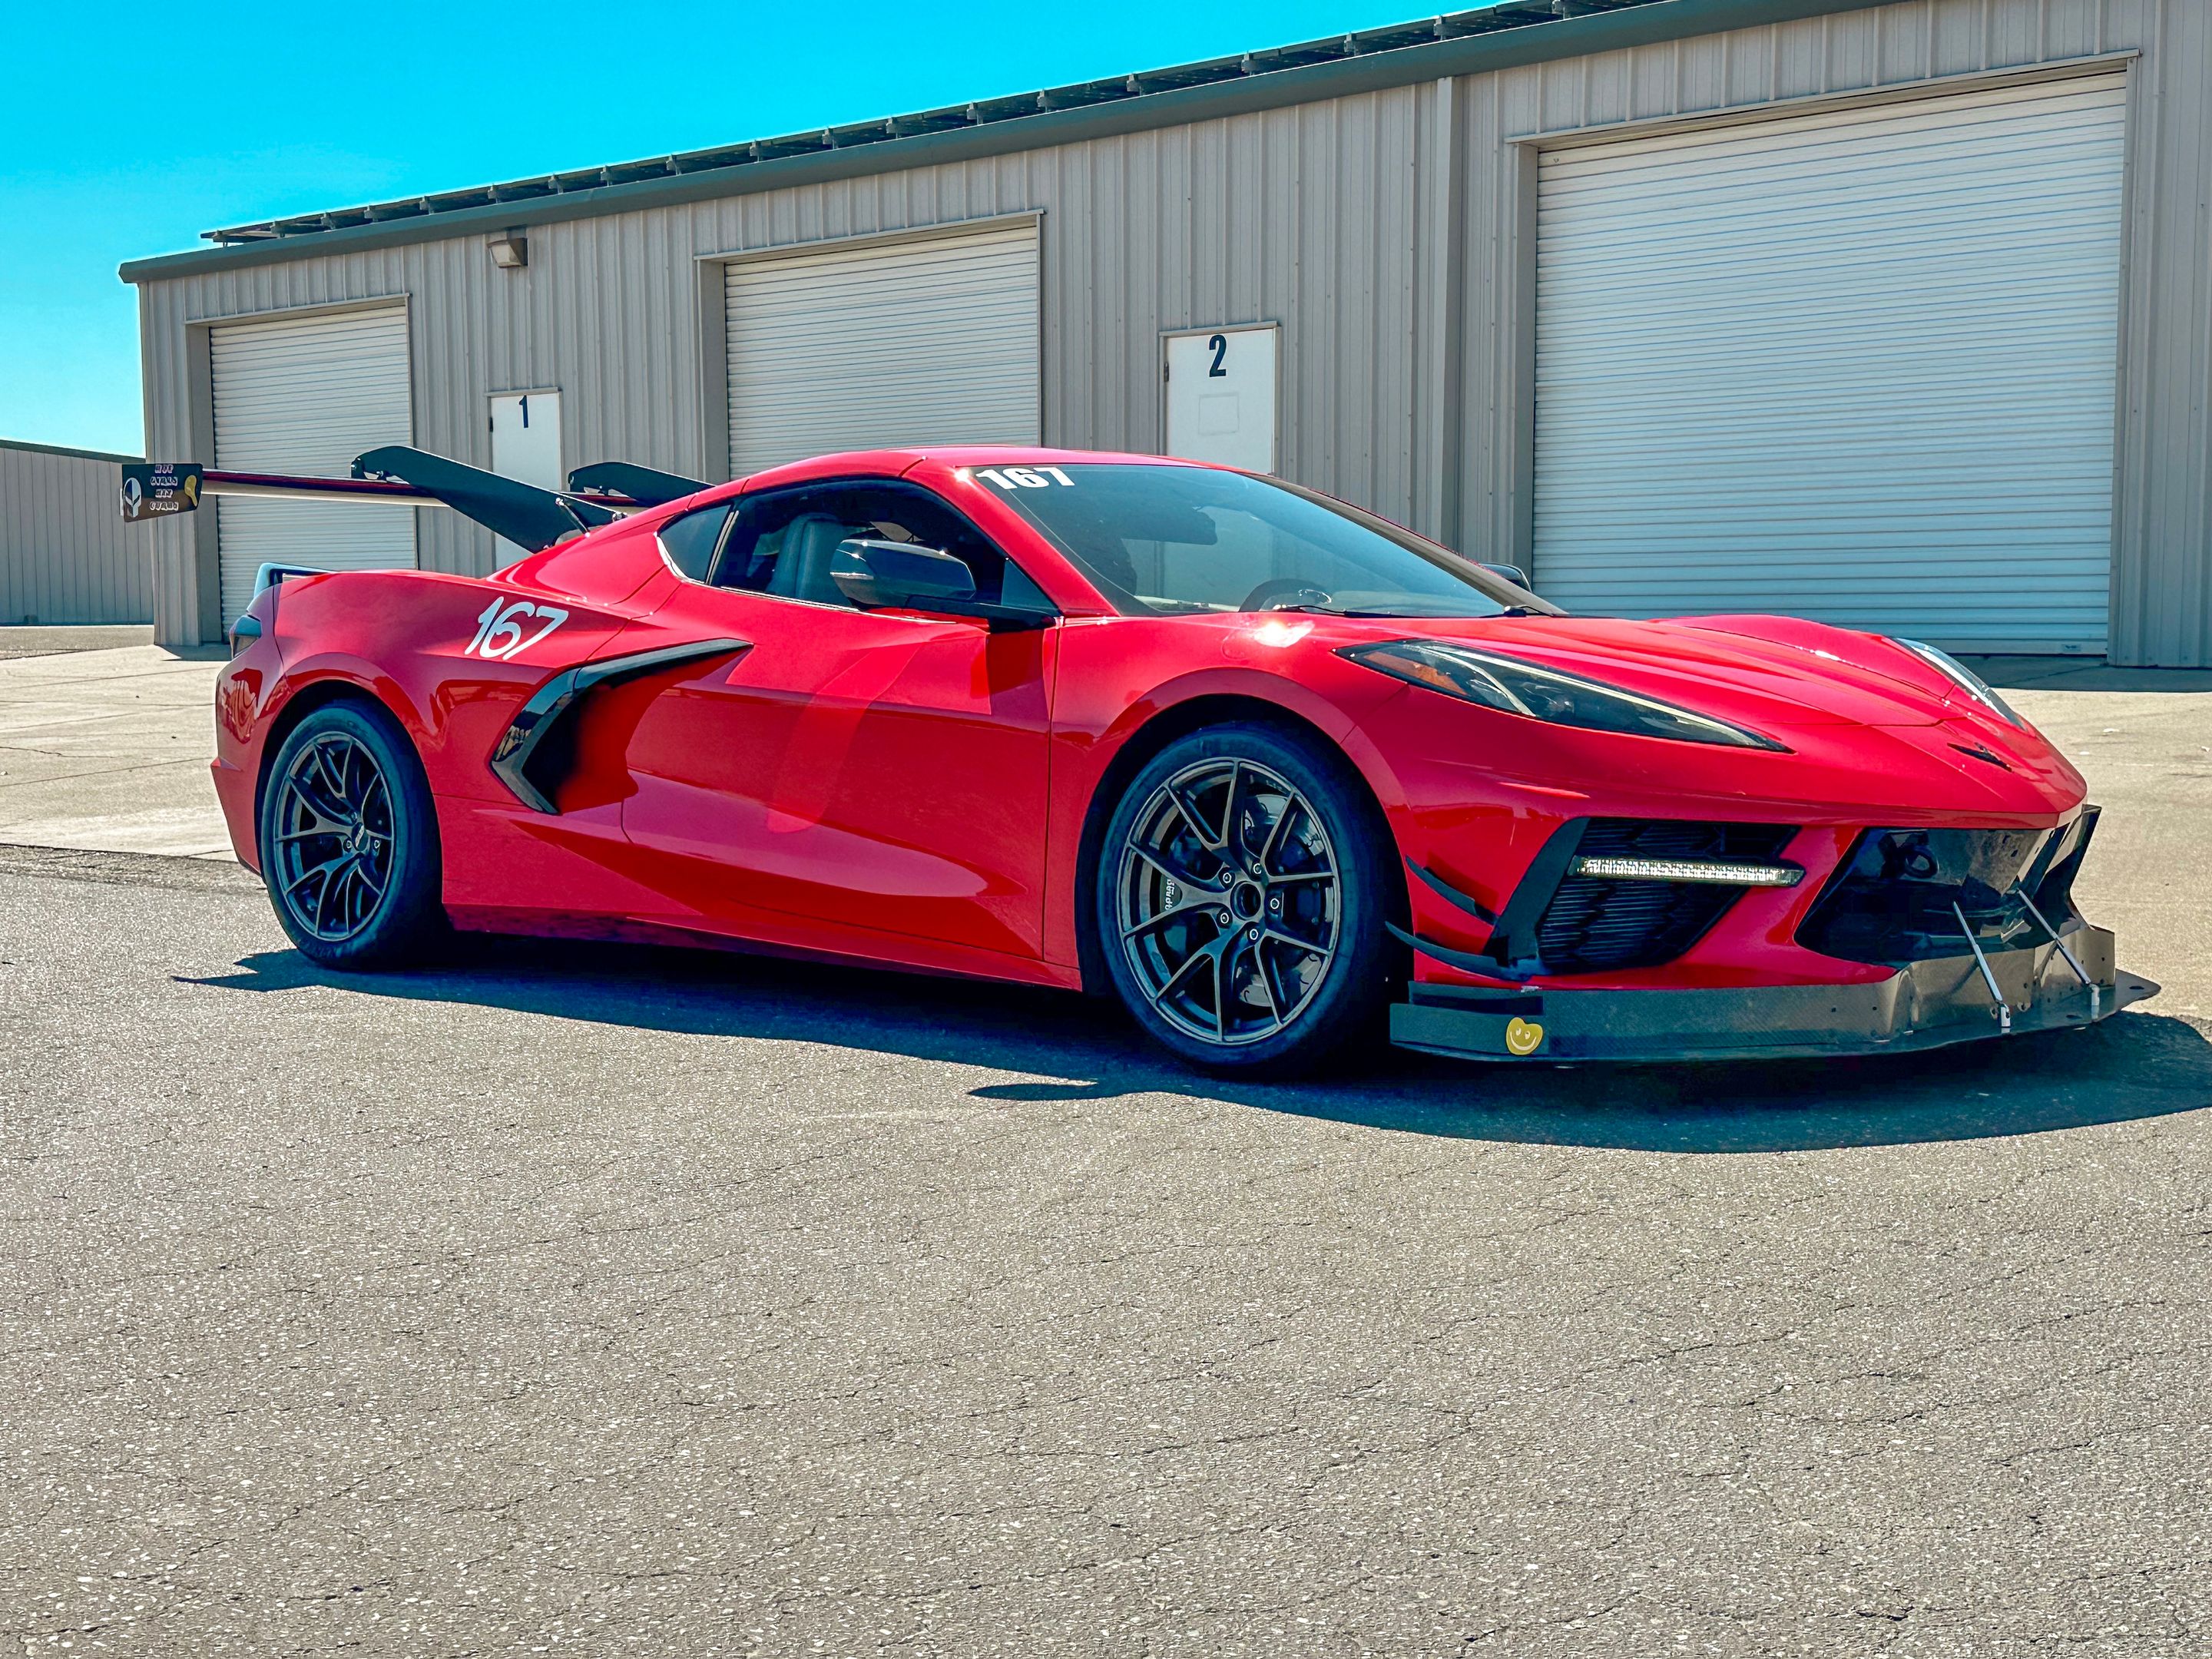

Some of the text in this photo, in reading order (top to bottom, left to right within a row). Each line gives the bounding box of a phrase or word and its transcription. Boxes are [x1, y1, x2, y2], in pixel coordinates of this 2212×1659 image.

[1209, 335, 1227, 377] 2
[518, 395, 528, 428] 1
[975, 467, 1075, 489] 167
[464, 596, 568, 661] 167
